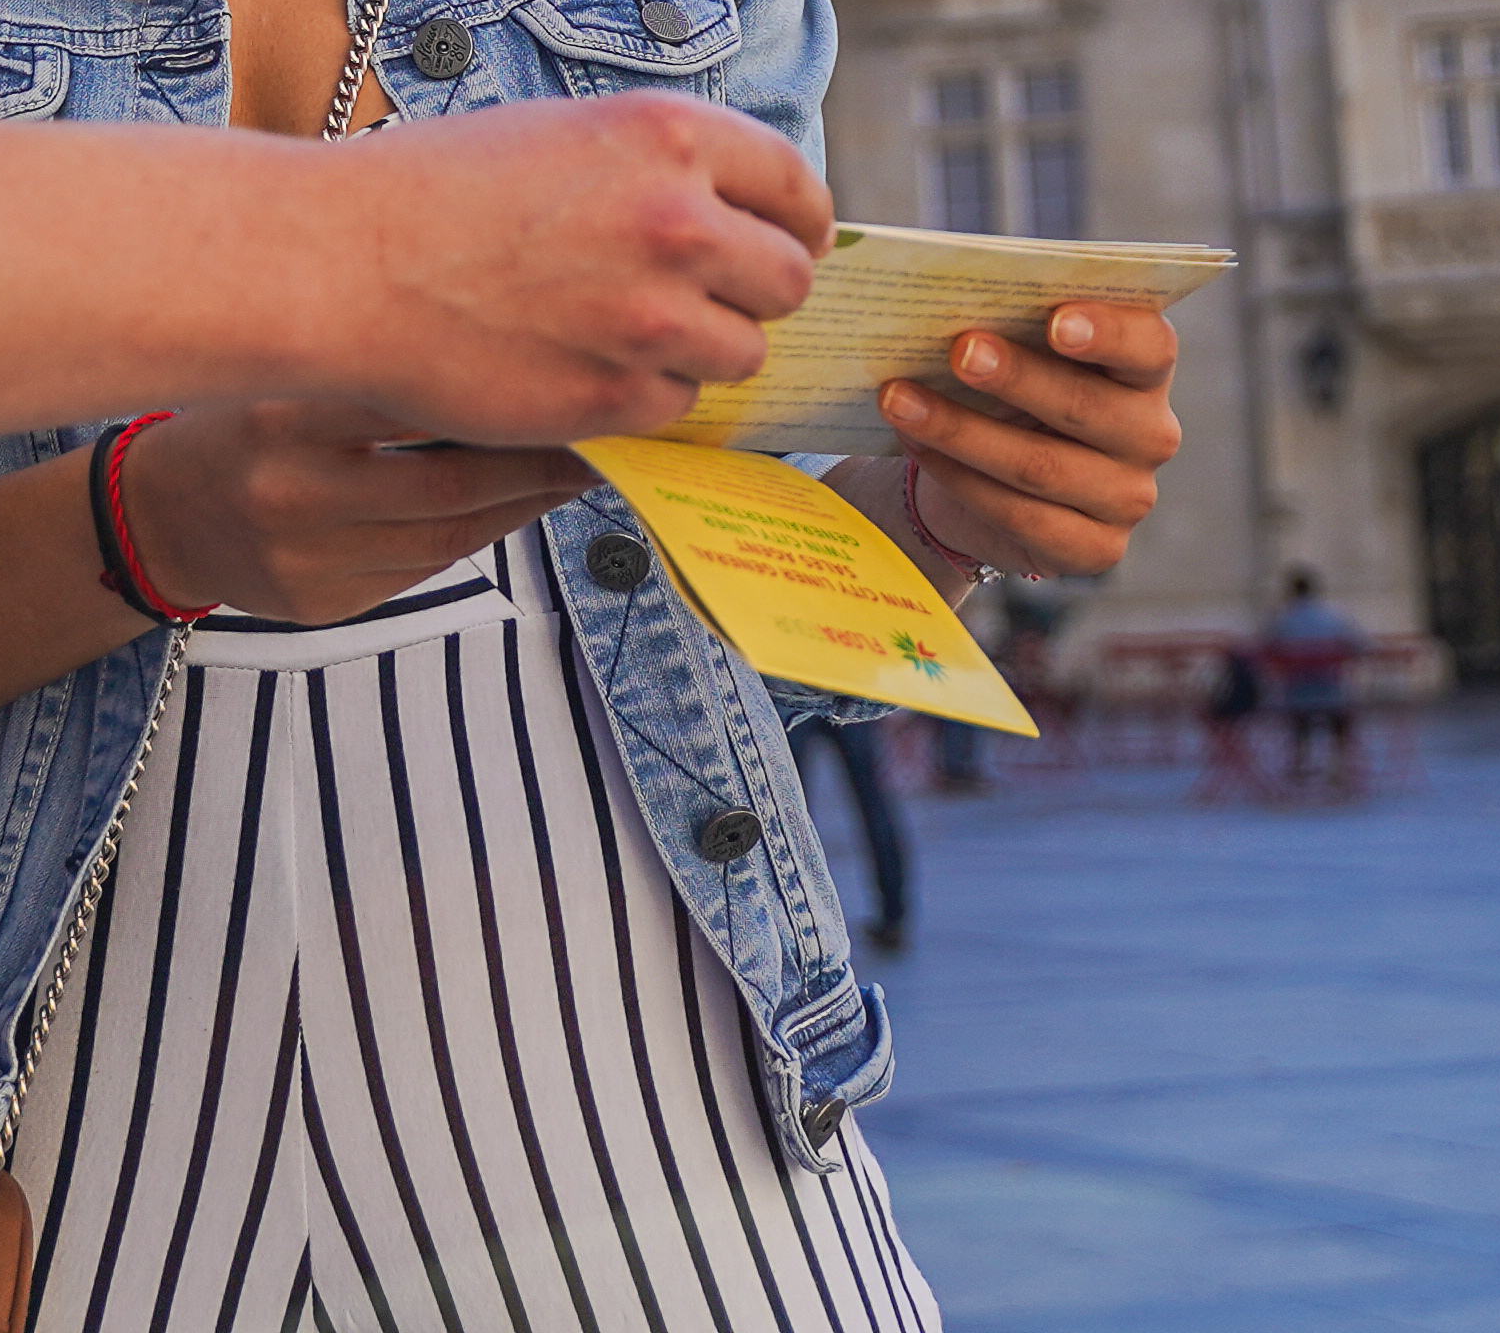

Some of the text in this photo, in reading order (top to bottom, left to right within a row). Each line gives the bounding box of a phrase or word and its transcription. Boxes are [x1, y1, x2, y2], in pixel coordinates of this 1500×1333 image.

[655, 487, 860, 547] GENERALVERTRETUNG
[703, 515, 854, 561] TWIN CITY LINER
[688, 544, 932, 615] TWIN CITY LINER GENERAL
[734, 537, 857, 579] SALES AGENT
[774, 617, 888, 655] FLORATOUR
